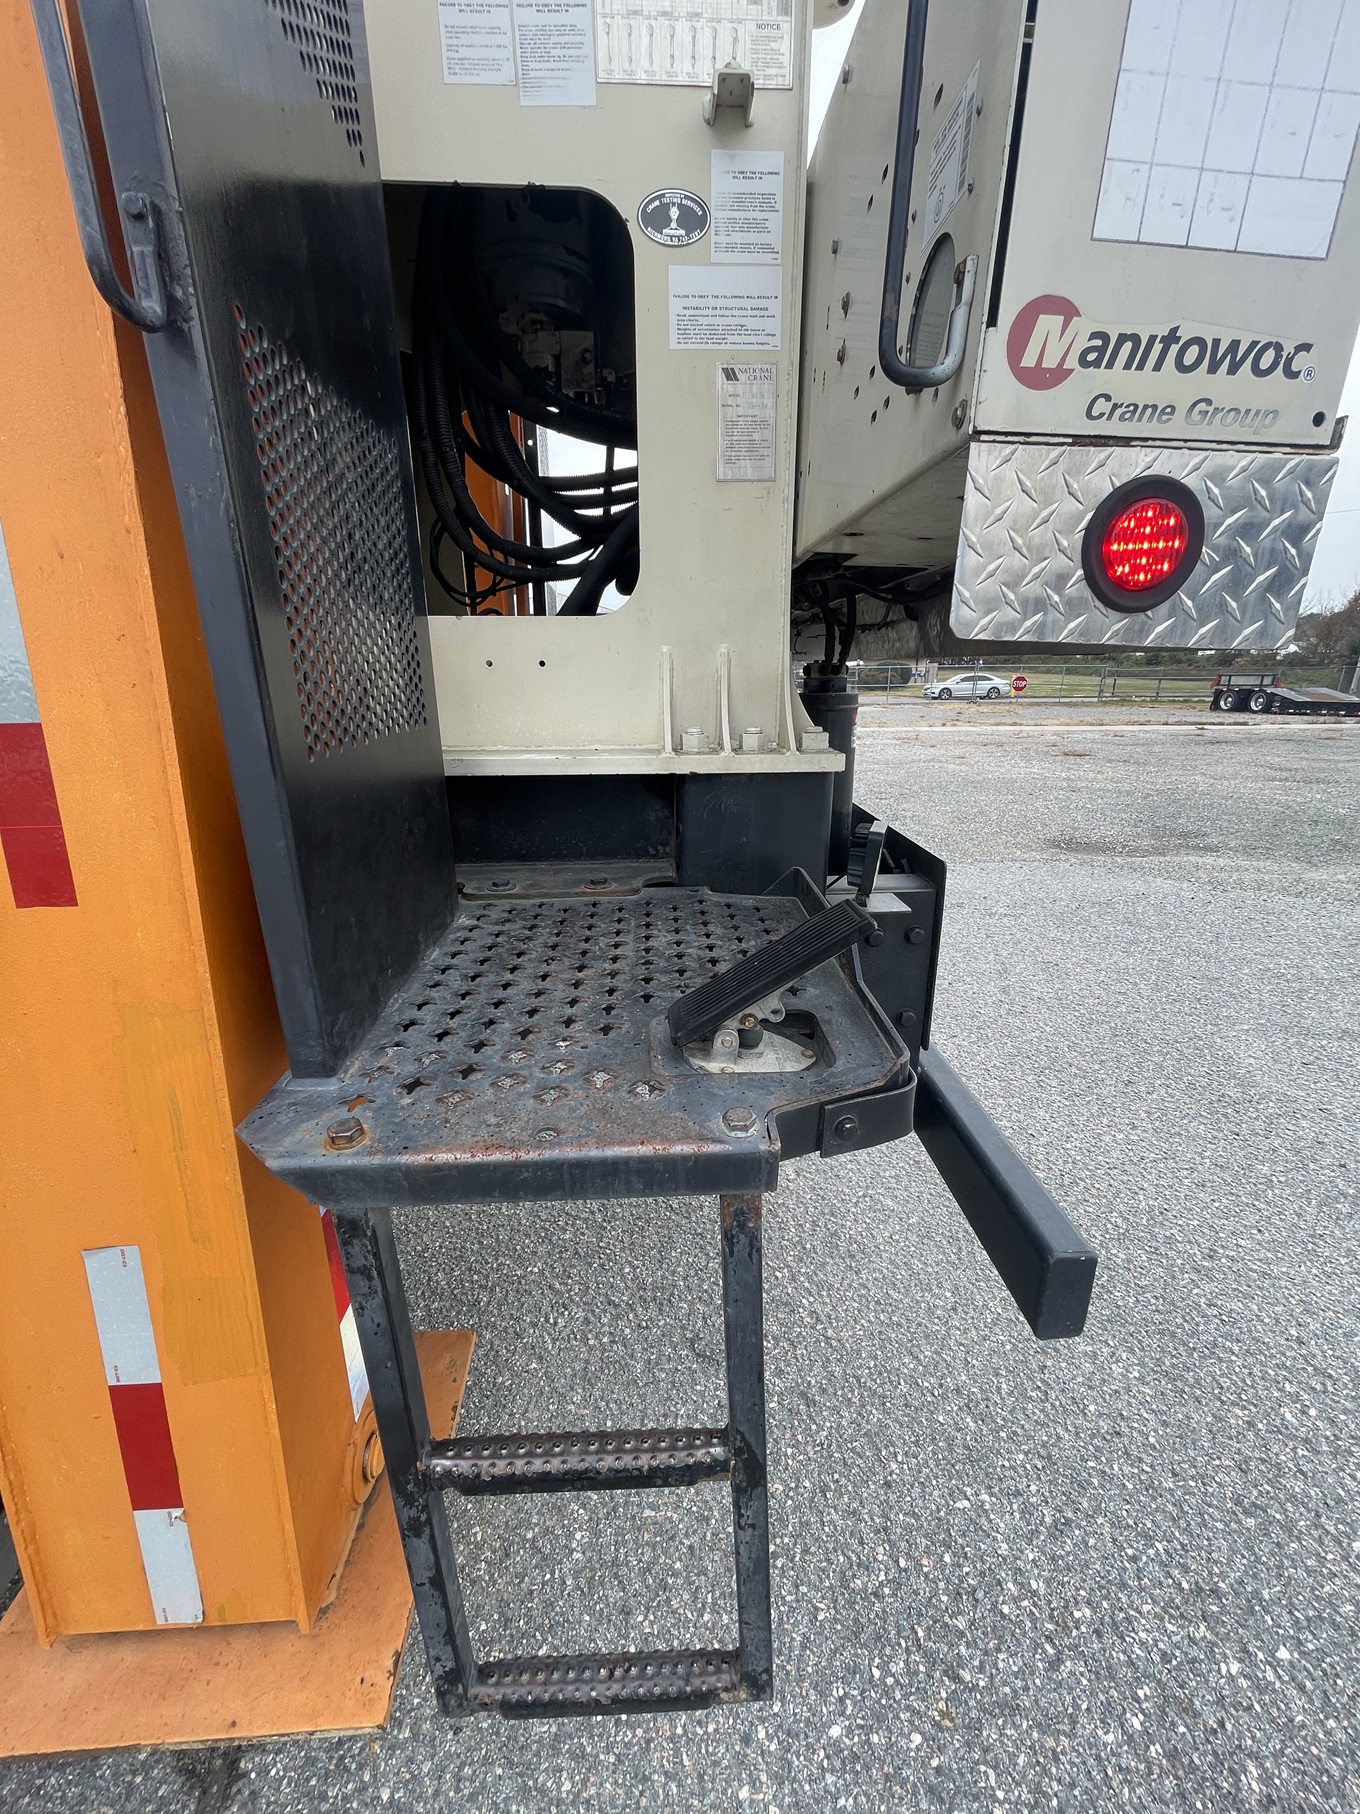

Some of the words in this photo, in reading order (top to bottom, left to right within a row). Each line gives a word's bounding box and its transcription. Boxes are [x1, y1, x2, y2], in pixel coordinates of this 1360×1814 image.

[756, 23, 781, 31] NOTICE
[647, 200, 660, 213] CRANE
[682, 199, 702, 215] SERVICES
[1020, 314, 1315, 380] Manitowoc
[1084, 393, 1176, 425] Crane
[1184, 397, 1280, 434] Group
